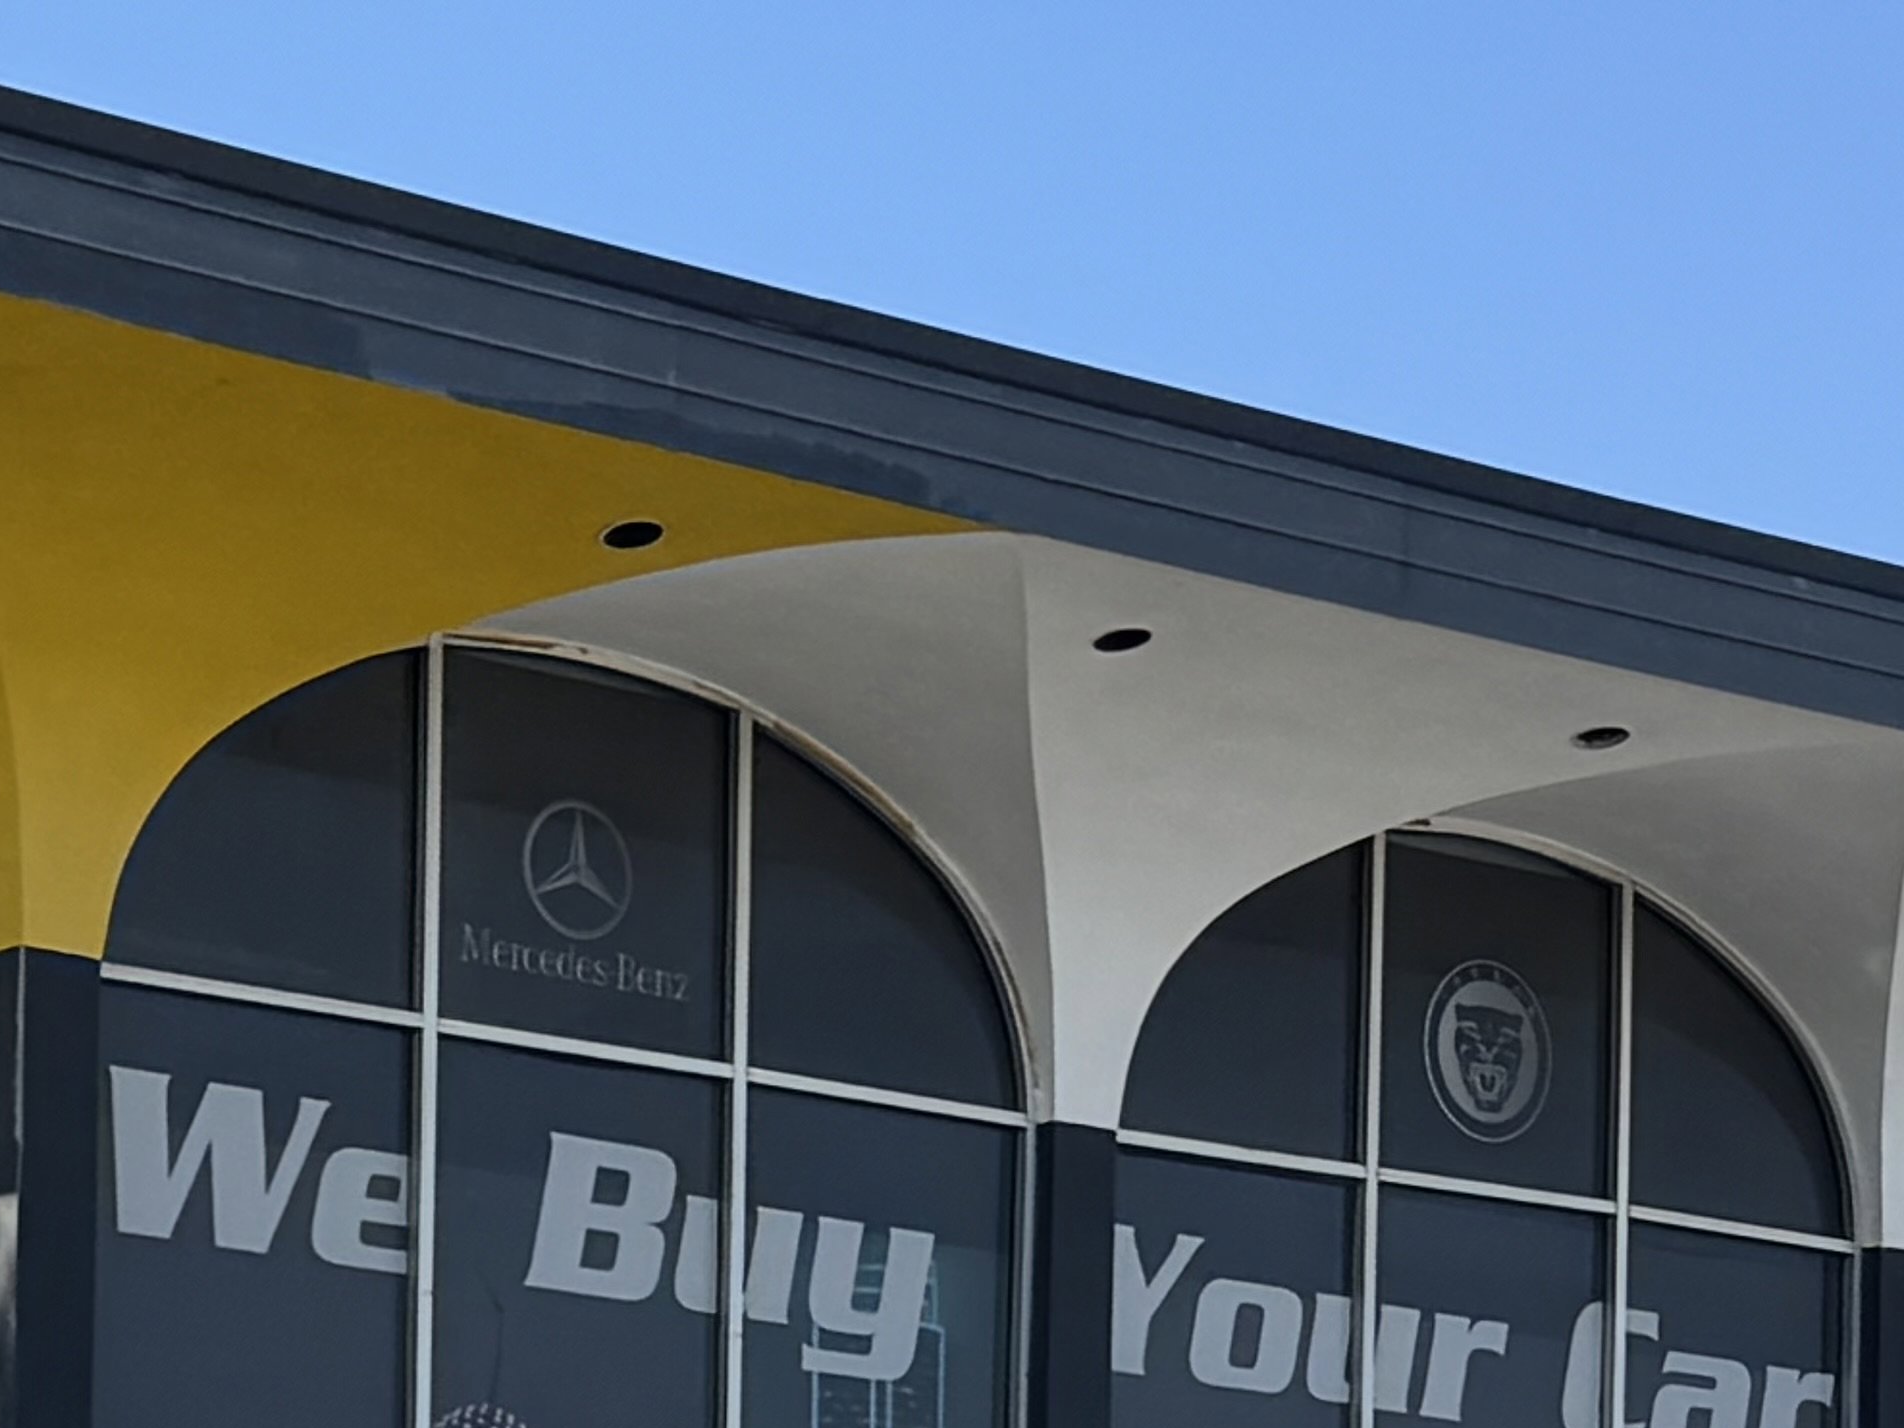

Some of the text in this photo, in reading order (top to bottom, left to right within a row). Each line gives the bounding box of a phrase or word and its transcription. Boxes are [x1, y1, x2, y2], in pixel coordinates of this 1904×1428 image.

[107, 1063, 410, 1276] We
[521, 1130, 936, 1383] Buy
[1110, 1222, 1510, 1424] Your
